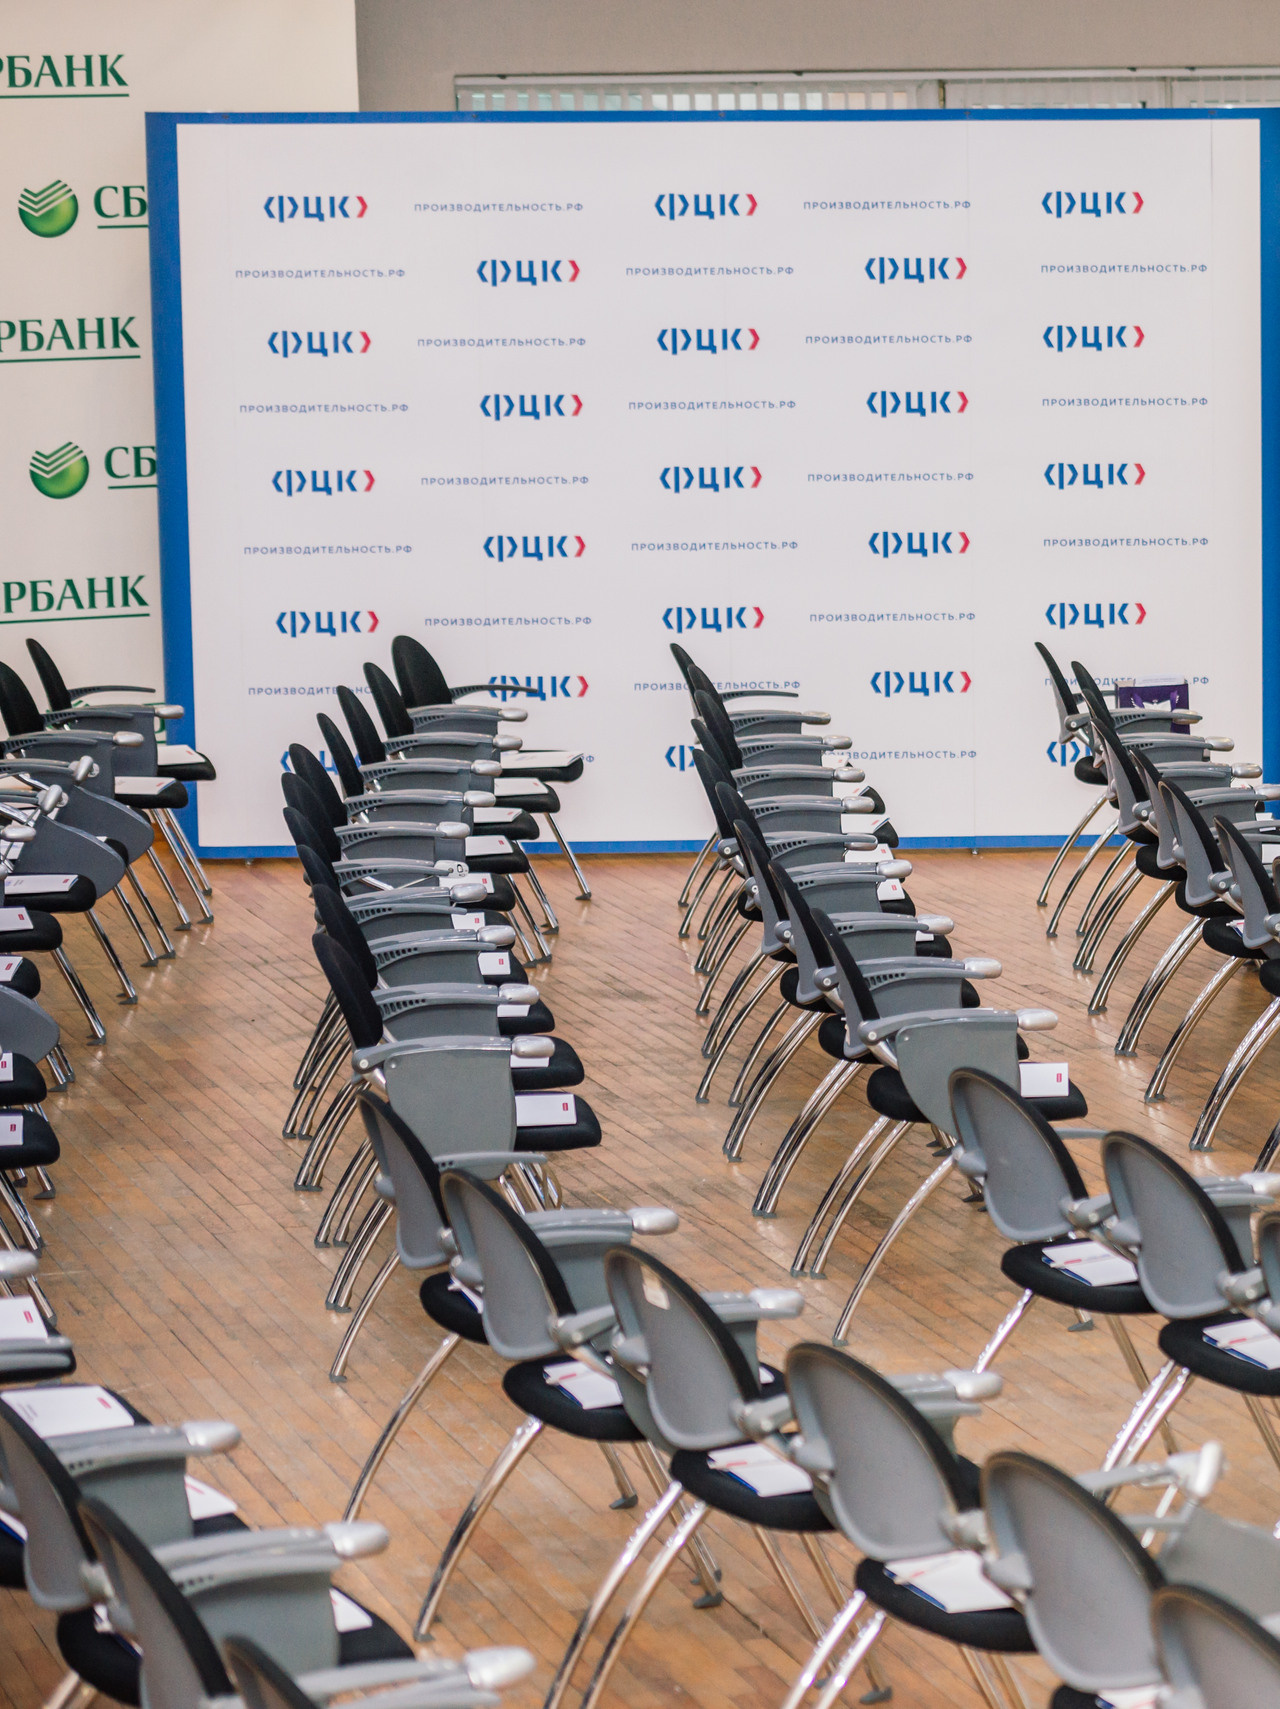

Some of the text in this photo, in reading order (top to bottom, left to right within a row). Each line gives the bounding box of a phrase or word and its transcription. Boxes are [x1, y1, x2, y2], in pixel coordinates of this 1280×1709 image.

[0, 54, 129, 88] БАНК
[264, 195, 350, 223] ФЦК
[414, 202, 584, 213] ПРОИЗВОДИТЕЛЬНОСТЬ.РФ
[654, 193, 739, 221] ФЦК
[803, 200, 971, 210] ПРОИЗВОДИТЕЛЬНОСТЬ.РФ
[1042, 191, 1126, 218] ФЦК
[235, 269, 406, 279] ПРОИЗВОДИТЕЛЬНОСТЬ.РФ
[476, 259, 562, 287] ФЦК
[625, 266, 793, 277] ПРОИЗВОДИТЕЛЬНОСТЬ.РФ
[865, 257, 949, 284] ФЦК
[1041, 264, 1208, 274] ПРОИЗВОДИТЕЛЬНОСТЬ.РФ
[268, 330, 353, 358] ФЦК
[417, 337, 586, 348] ПРОИЗВОДИТЕЛЬНОСТЬ.РФ
[657, 328, 742, 355] ФЦК
[805, 335, 973, 345] ПРОИЗВОДИТЕЛЬНОСТЬ.РФ
[1043, 325, 1127, 352] ФЦК
[239, 403, 409, 413] ПРОИЗВОДИТЕЛЬНОСТЬ.РФ
[480, 393, 565, 421] ФЦК
[628, 400, 797, 411] ПРОИЗВОДИТЕЛЬНОСТЬ.РФ
[866, 390, 951, 418] ФЦК
[1041, 397, 1208, 407] ПРОИЗВОДИТЕЛЬНОСТЬ.РФ
[272, 469, 357, 497] ФЦК
[422, 475, 588, 486] ПРОИЗВОДИТЕЛЬНОСТЬ.РФ
[659, 466, 744, 494] ФЦК
[807, 472, 974, 483] ПРОИЗВОДИТЕЛЬНОСТЬ.РФ
[1044, 462, 1128, 490] ФЦК
[243, 544, 412, 555] ПРОИЗВОДИТЕЛЬНОСТЬ.РФ
[483, 535, 568, 562] ФЦК
[631, 541, 798, 552] ПРОИЗВОДИТЕЛЬНОСТЬ.РФ
[868, 531, 952, 558] ФЦК
[1043, 537, 1209, 548] ПРОИЗВОДИТЕЛЬНОСТЬ.РФ
[276, 611, 361, 638] ФЦК
[424, 616, 593, 627] ПРОИЗВОДИТЕЛЬНОСТЬ.РФ
[662, 606, 747, 634] ФЦК
[809, 612, 976, 623] ПРОИЗВОДИТЕЛЬНОСТЬ.РФ
[1045, 602, 1129, 630] ФЦК
[248, 686, 373, 696] ПРОИЗВОДИТЕНО
[488, 675, 571, 702] ФЦК
[633, 680, 801, 691] ПРОИЗВОЕЛЬНОСТЬ.РФ
[870, 670, 954, 698] ФЦК
[823, 750, 977, 761] ЗВОДИТЕЛЬНОСТЬ.РФ
